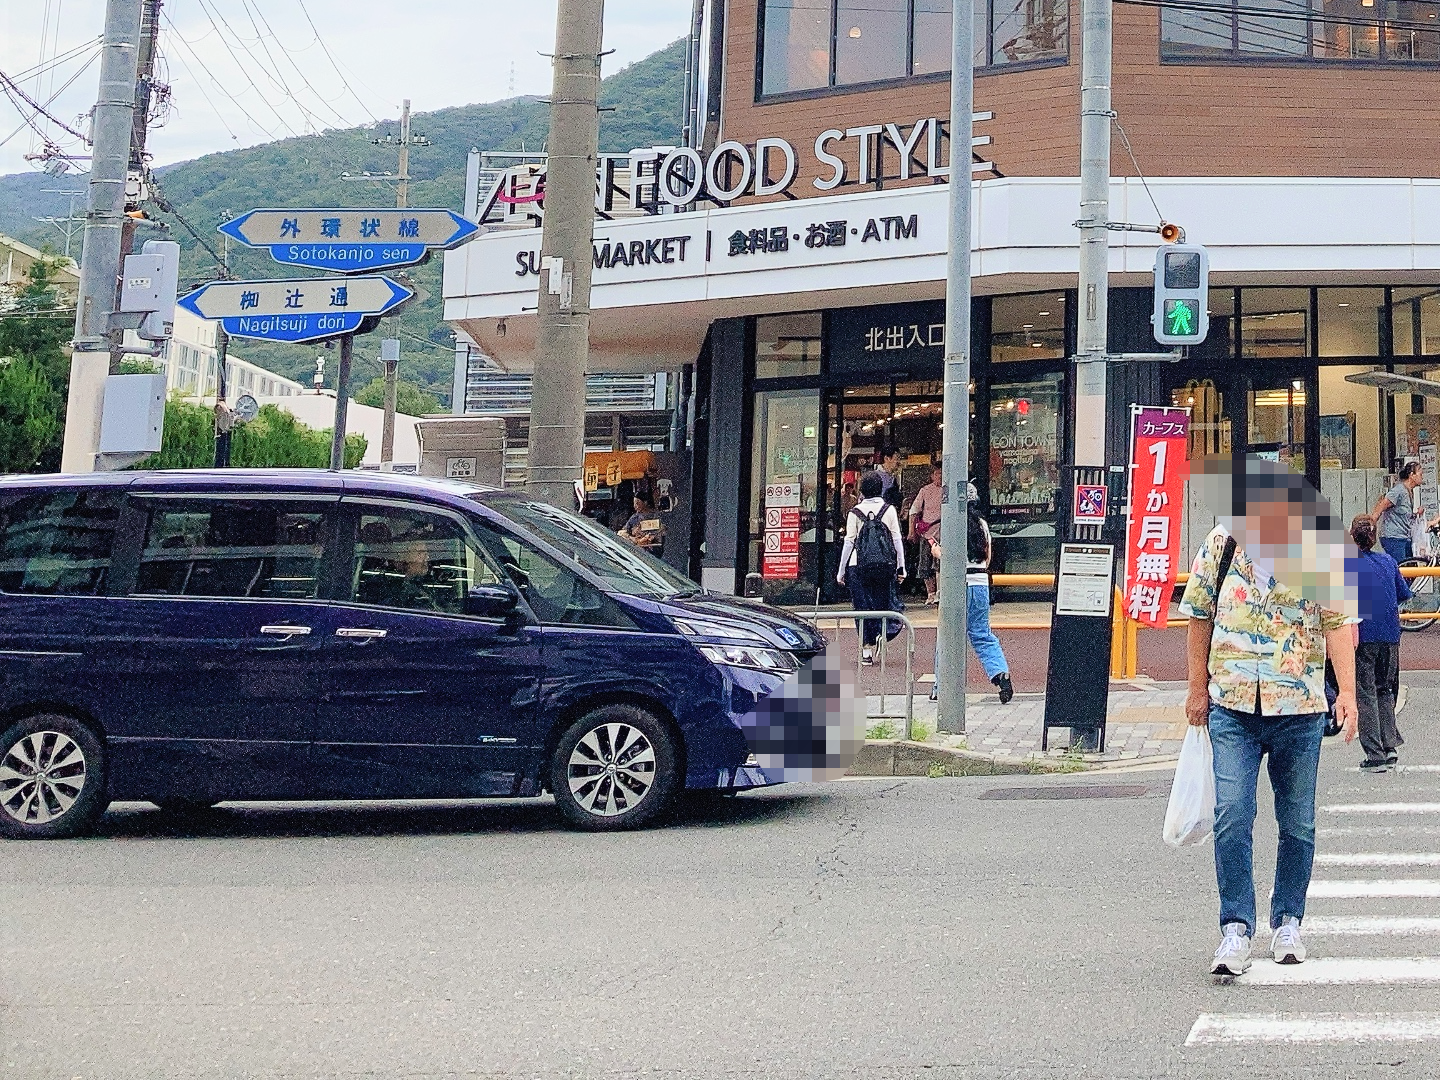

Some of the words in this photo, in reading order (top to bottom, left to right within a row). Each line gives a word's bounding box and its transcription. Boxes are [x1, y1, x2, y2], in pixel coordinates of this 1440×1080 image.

[631, 138, 797, 210] FOOD
[813, 112, 993, 191] STYLE
[280, 217, 420, 239] 外環状線
[288, 246, 374, 262] Sotokanjo
[382, 248, 410, 260] sen
[239, 317, 307, 334] Nagitsuji
[317, 314, 346, 329] dori
[864, 323, 945, 351] 北出入口
[1129, 440, 1170, 622] 1か月無料
